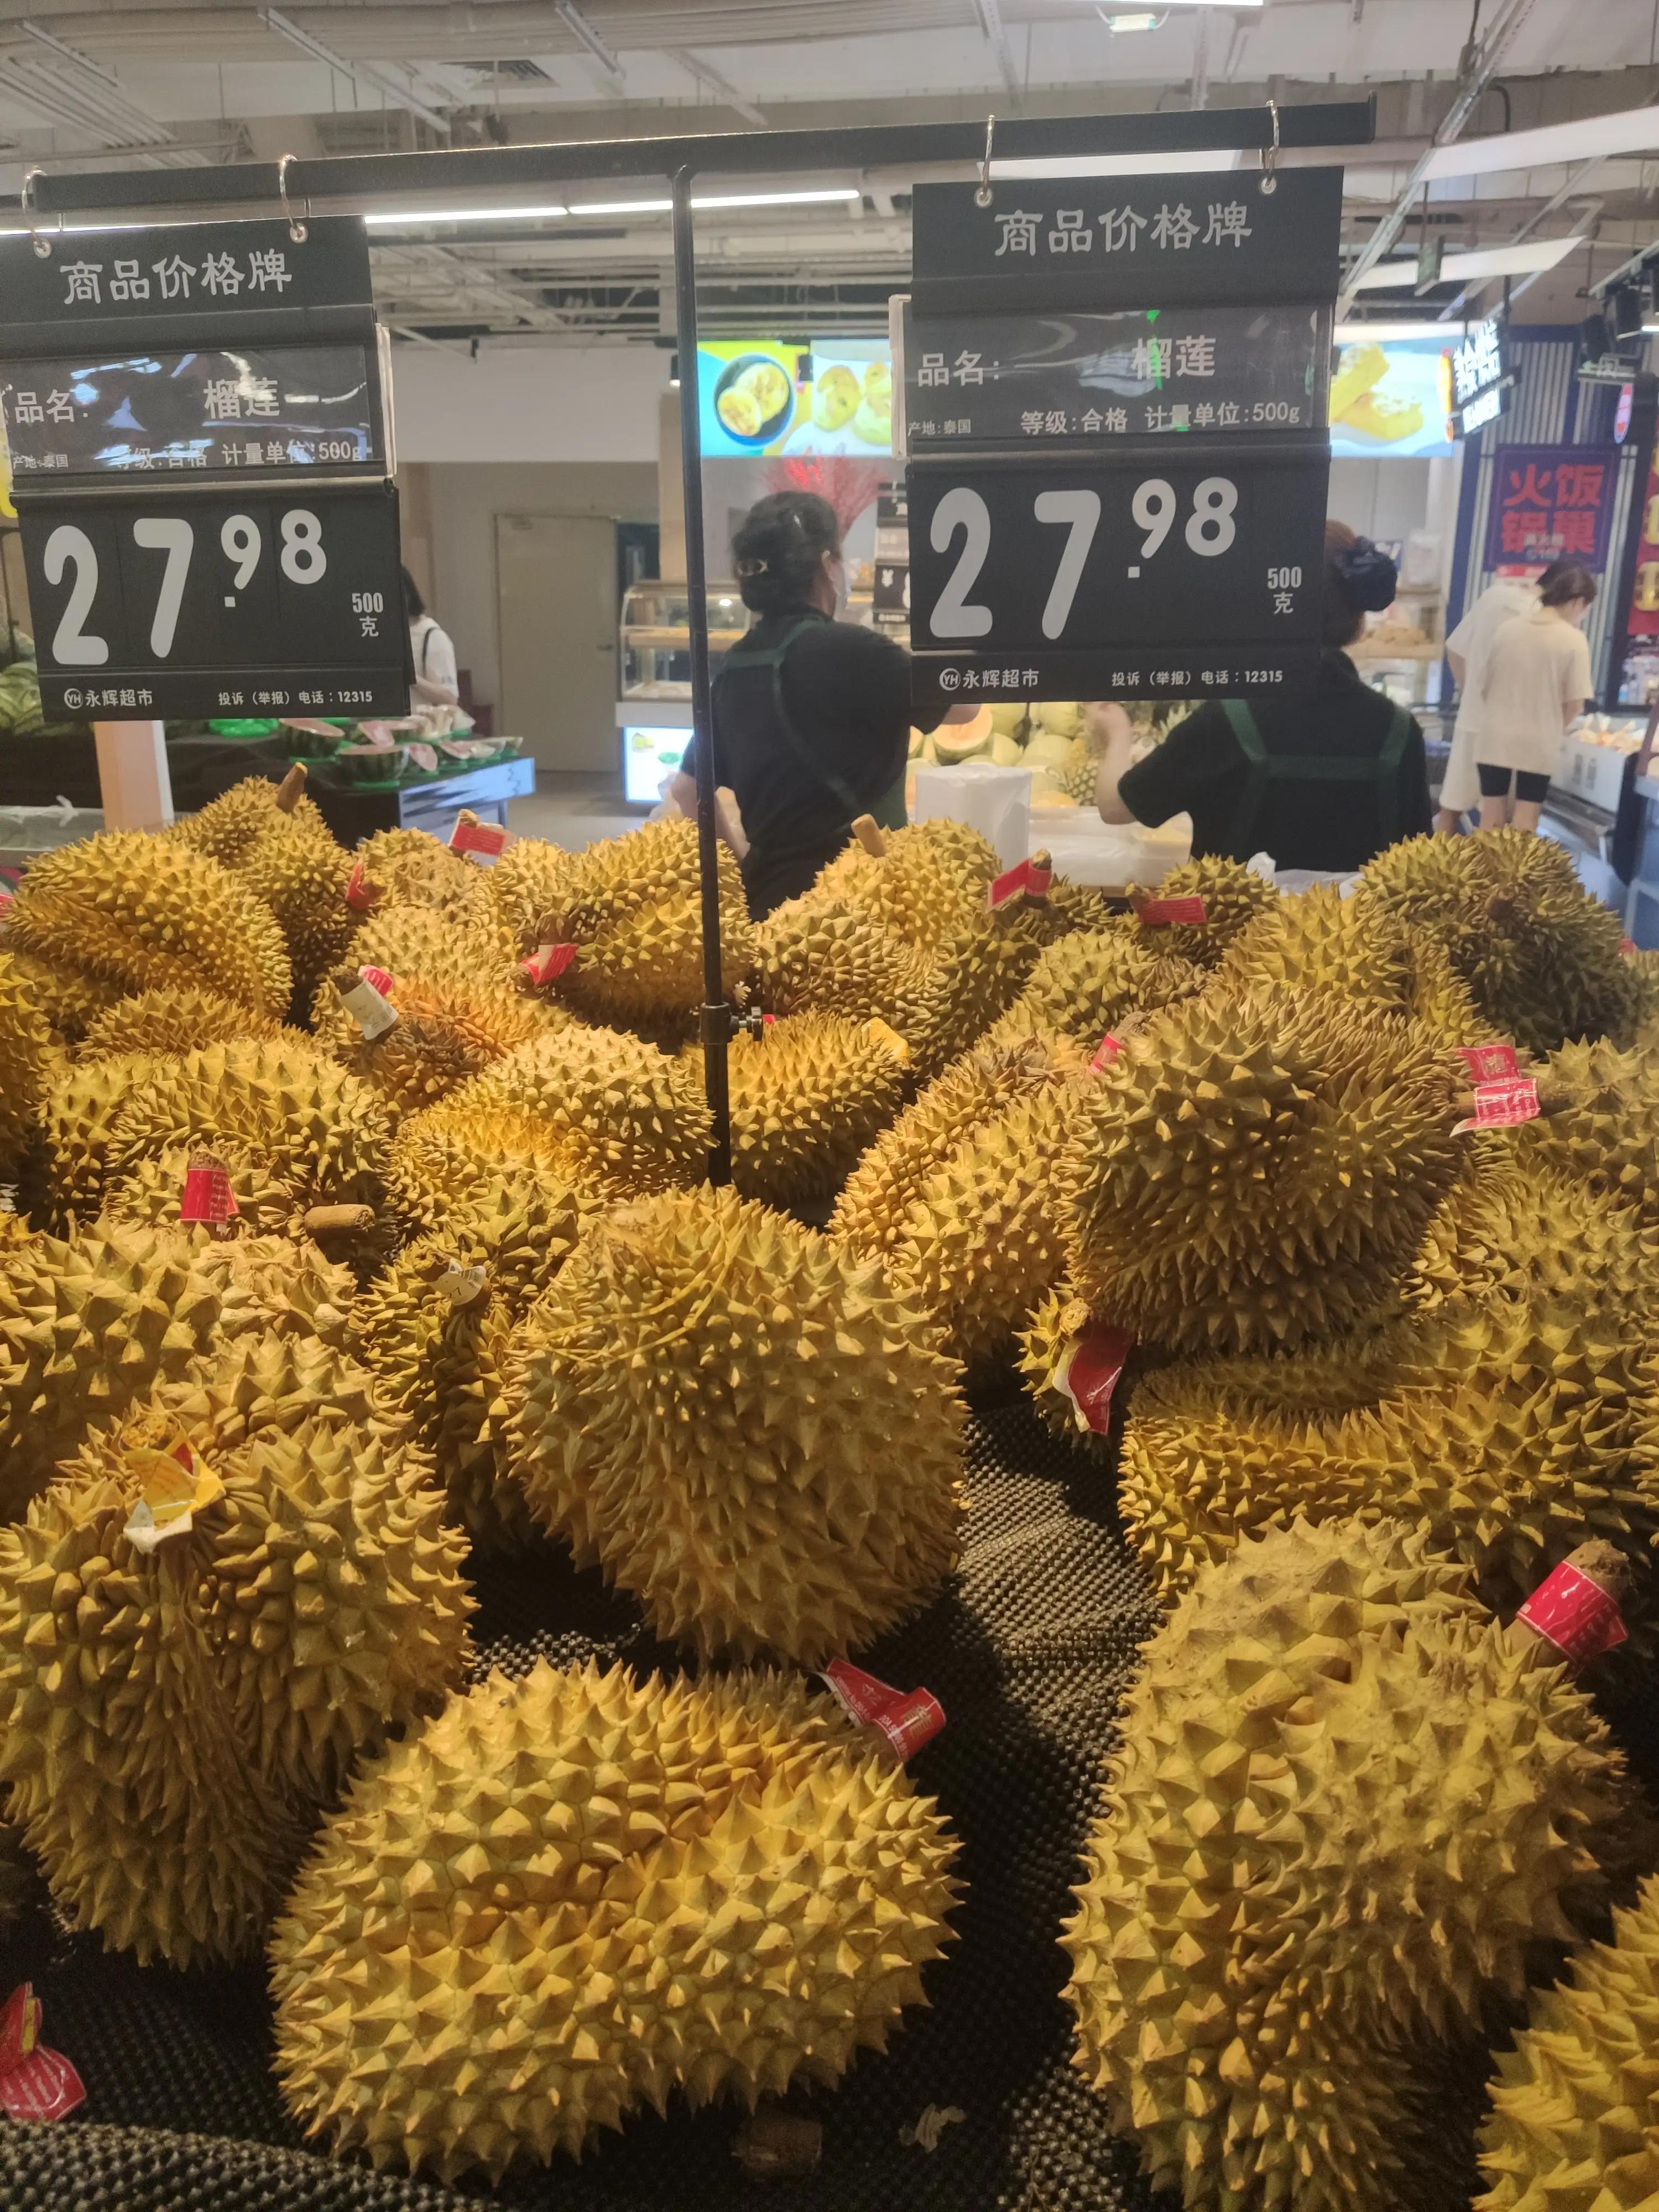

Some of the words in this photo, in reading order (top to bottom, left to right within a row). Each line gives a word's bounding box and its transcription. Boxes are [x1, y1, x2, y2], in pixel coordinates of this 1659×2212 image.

[995, 201, 1253, 257] 商品价格牌
[60, 248, 293, 305] 商品价格牌
[1131, 335, 1216, 380] 榴莲
[203, 377, 280, 419] 榴莲
[1267, 566, 1302, 589] 500
[352, 592, 384, 614] 500
[1274, 592, 1294, 615] 克
[359, 616, 379, 637] 克
[962, 669, 1039, 688] 永辉超市
[85, 688, 153, 707] 永辉超市
